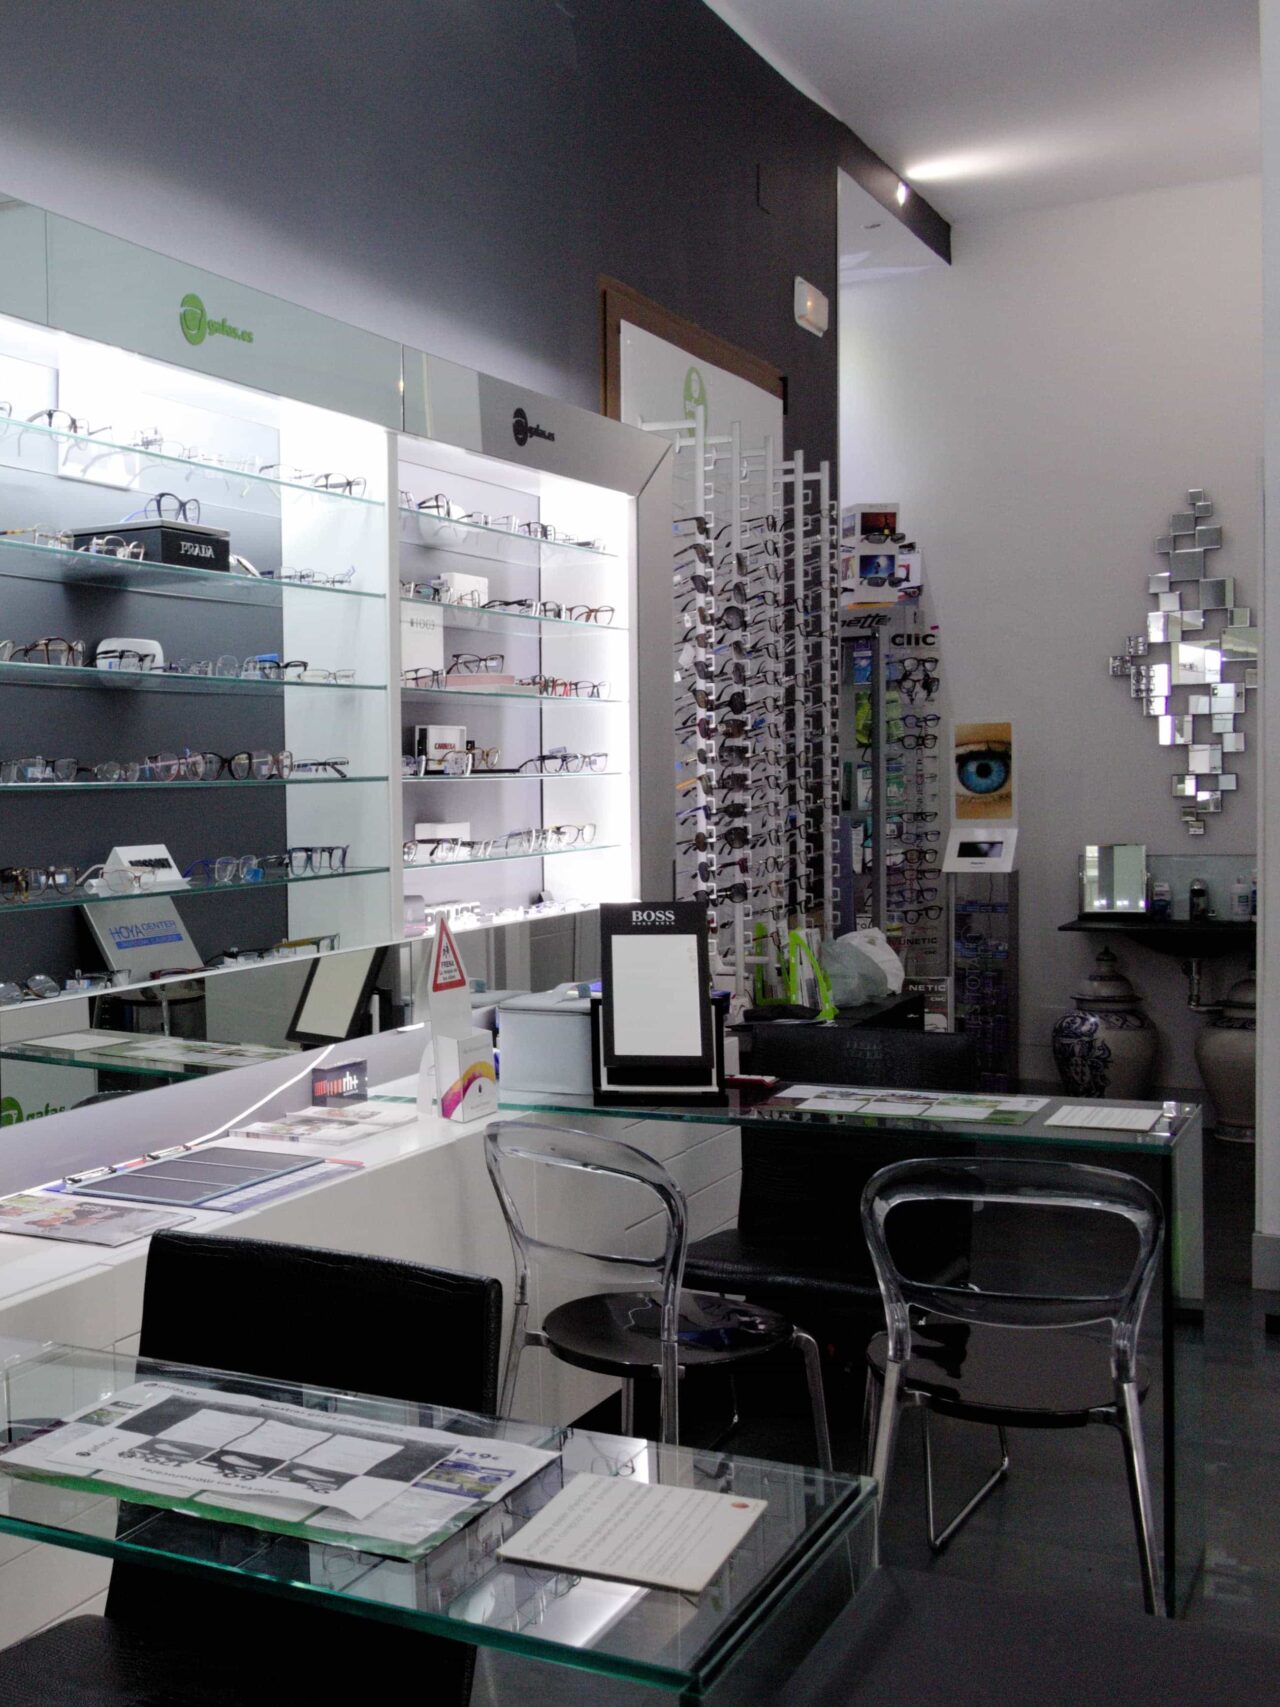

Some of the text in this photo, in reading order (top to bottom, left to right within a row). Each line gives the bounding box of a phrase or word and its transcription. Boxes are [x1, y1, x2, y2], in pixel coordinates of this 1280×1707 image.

[208, 318, 254, 343] gafas.es
[180, 541, 215, 558] PRADA
[632, 910, 676, 922] BOSS
[109, 922, 145, 941] HOYA
